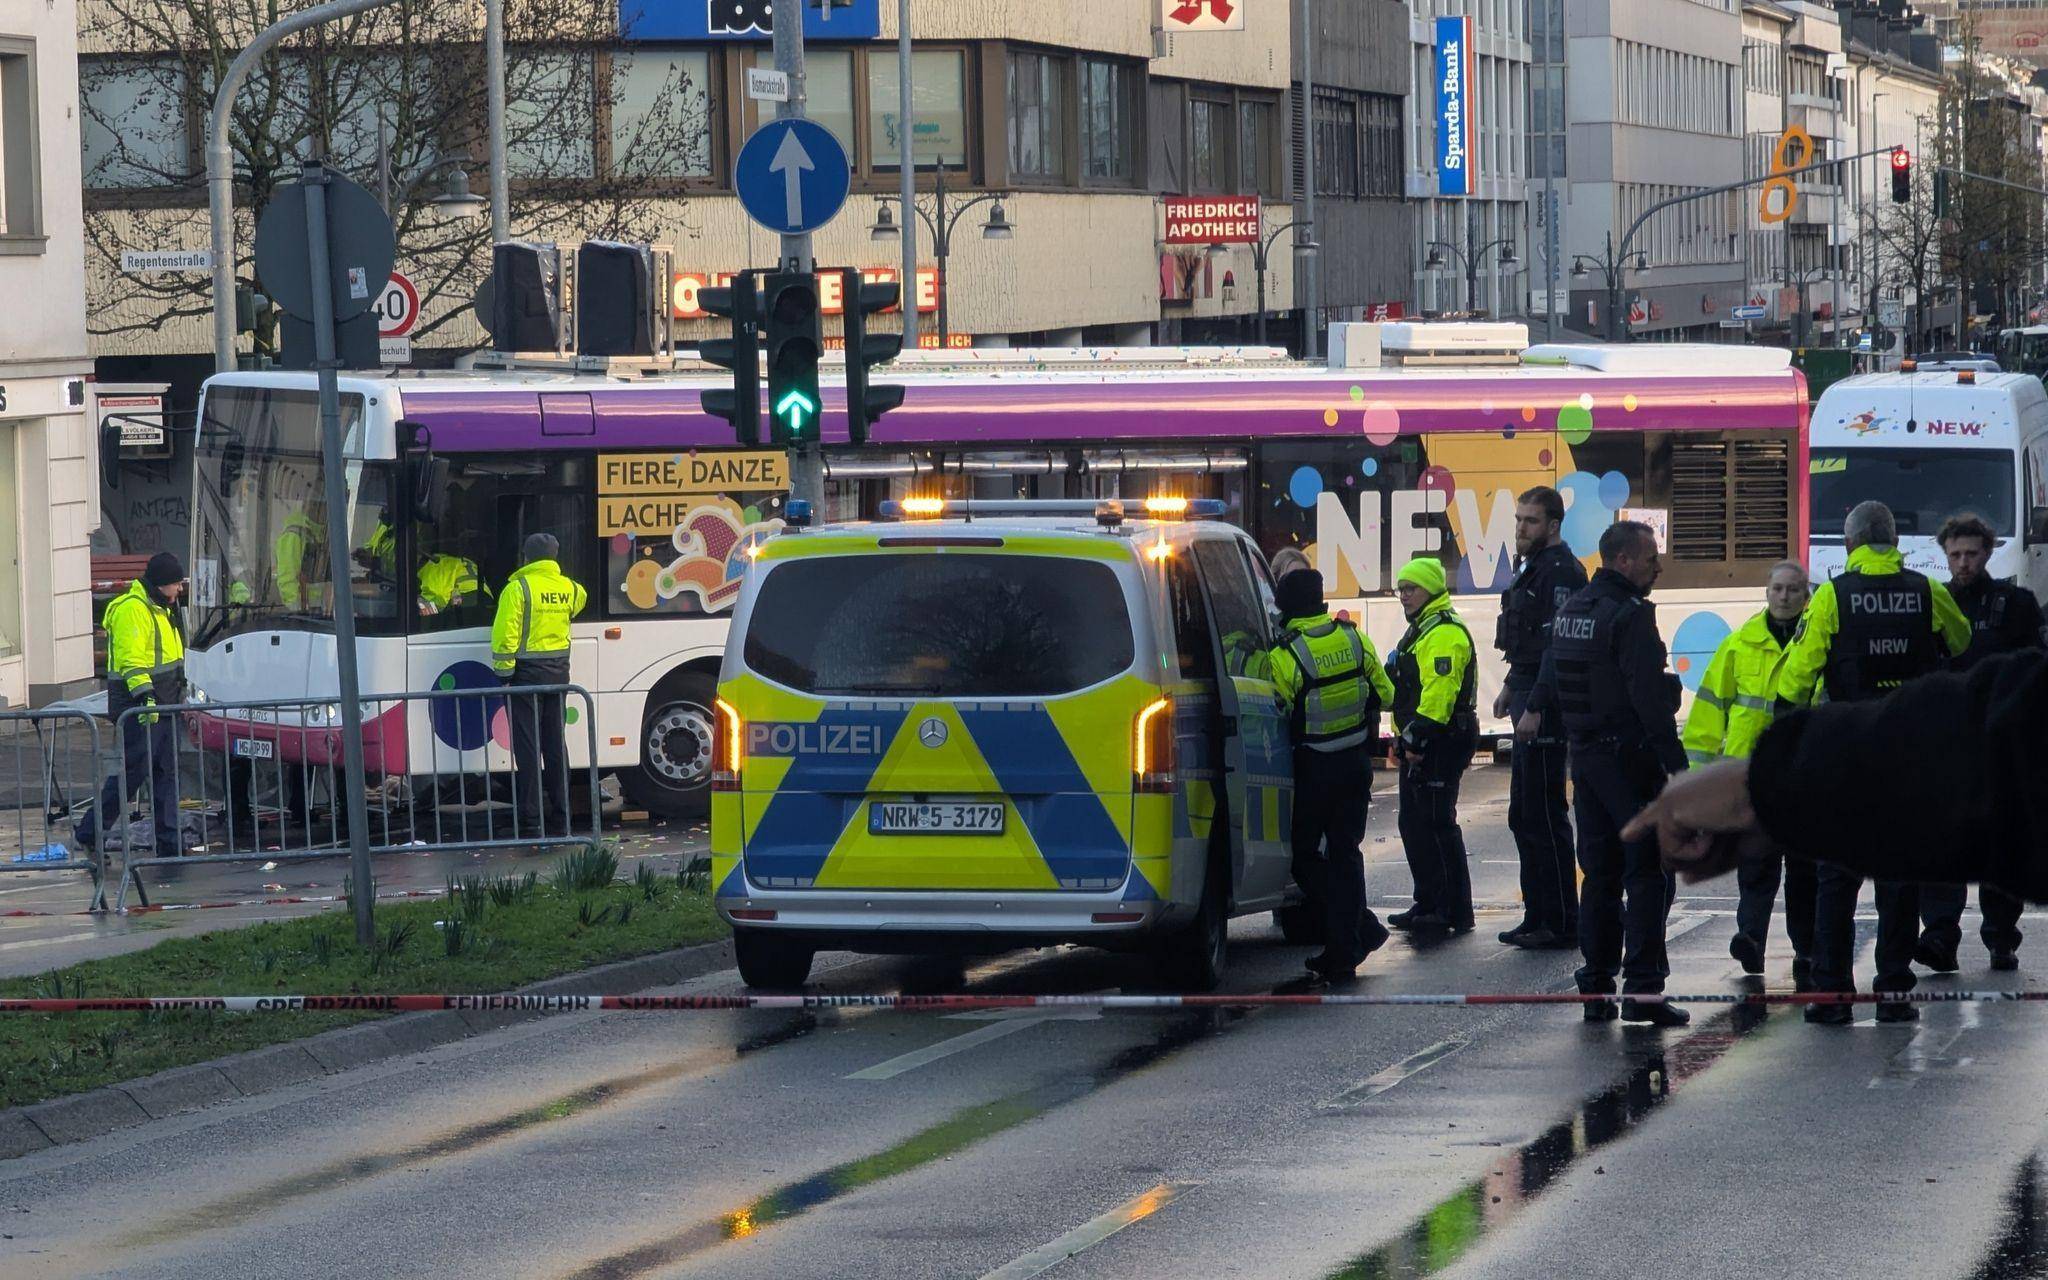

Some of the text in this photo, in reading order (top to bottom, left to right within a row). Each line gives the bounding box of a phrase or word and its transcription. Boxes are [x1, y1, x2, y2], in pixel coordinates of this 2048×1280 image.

[1444, 41, 1464, 169] Sparda-Bank
[1167, 203, 1257, 218] FRIEDRICH
[1168, 222, 1257, 237] APOTHEKE
[127, 254, 206, 270] Regentenstraße
[1927, 421, 1983, 435] NEW
[606, 459, 782, 488] FIERE, DANZE,
[607, 503, 688, 528] LACHE
[1317, 489, 1519, 592] NEW
[540, 592, 570, 604] NEW
[1851, 593, 1922, 613] POLIZEI
[1554, 616, 1596, 639] POLIZEI
[1869, 638, 1909, 655] NRW
[1316, 647, 1355, 669] POLIZEI
[750, 725, 881, 753] POLIZEI
[883, 807, 919, 827] NRW
[931, 806, 1002, 828] 5-3179
